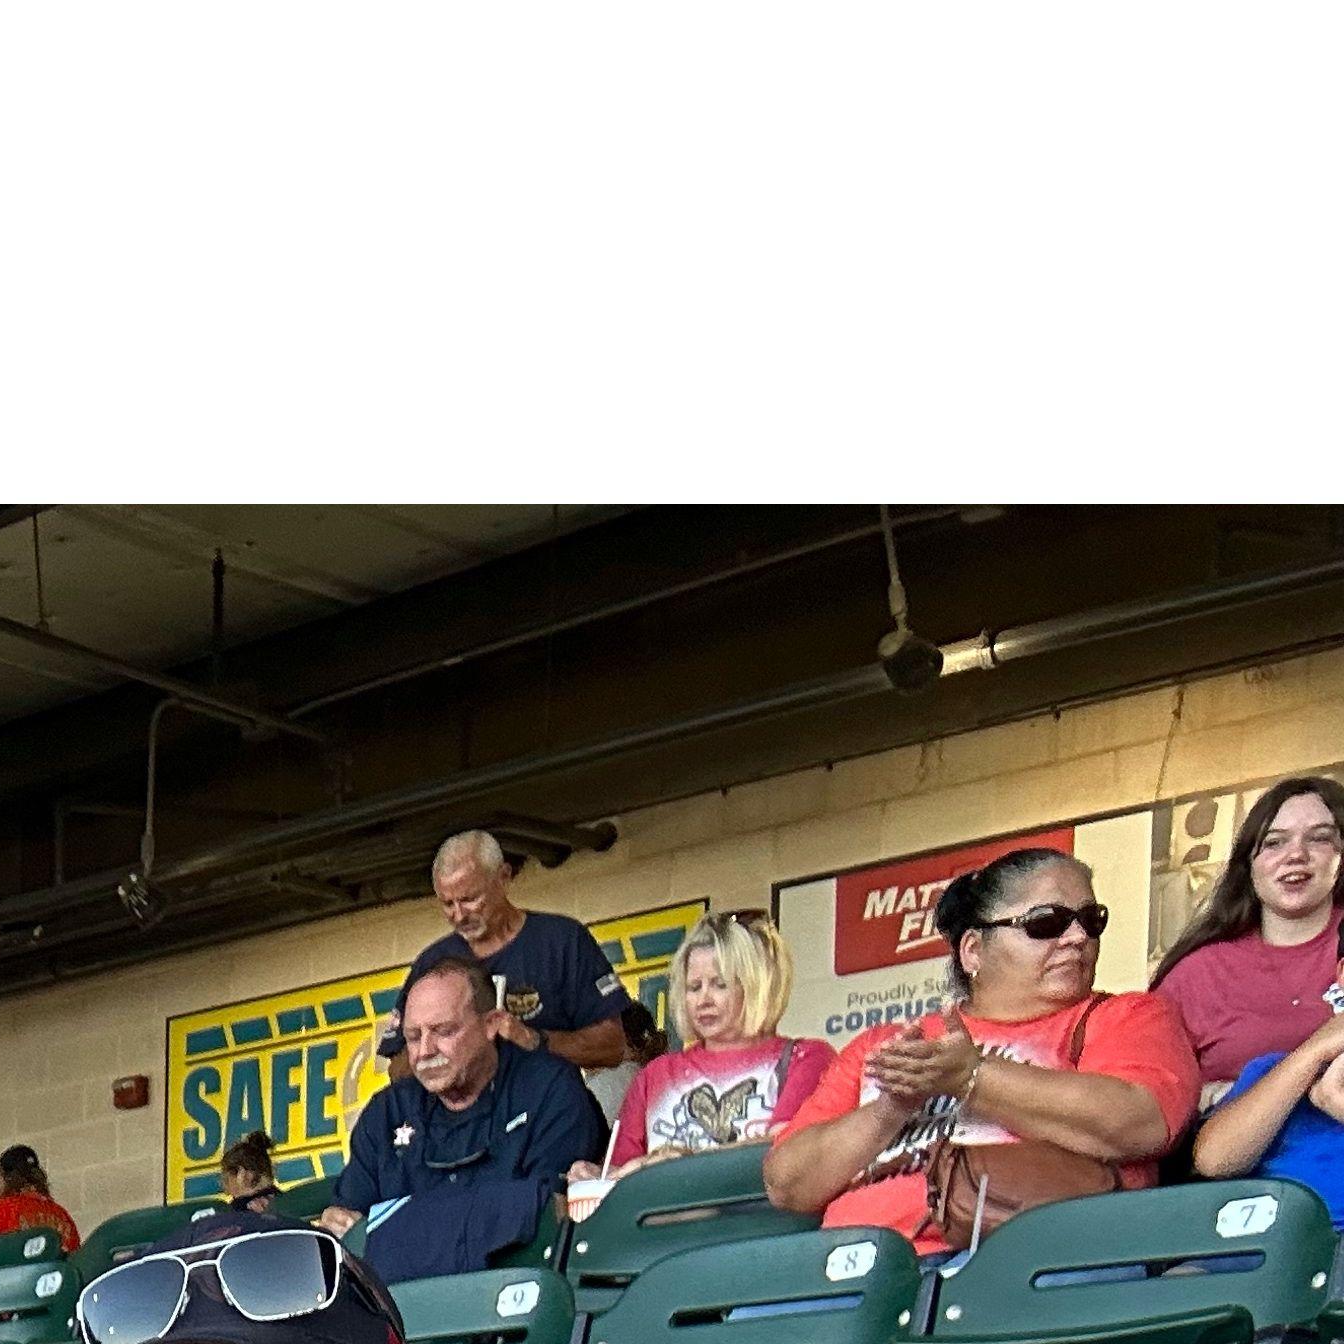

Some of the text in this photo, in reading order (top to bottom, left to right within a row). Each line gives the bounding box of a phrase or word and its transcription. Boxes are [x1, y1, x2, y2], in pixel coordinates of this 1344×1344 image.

[847, 976, 918, 1008] Proudly
[825, 996, 944, 1036] CORPUS
[182, 1039, 340, 1162] SAFE
[1239, 1204, 1257, 1229] 7
[845, 1249, 859, 1273] 8
[512, 1288, 525, 1307] 9
